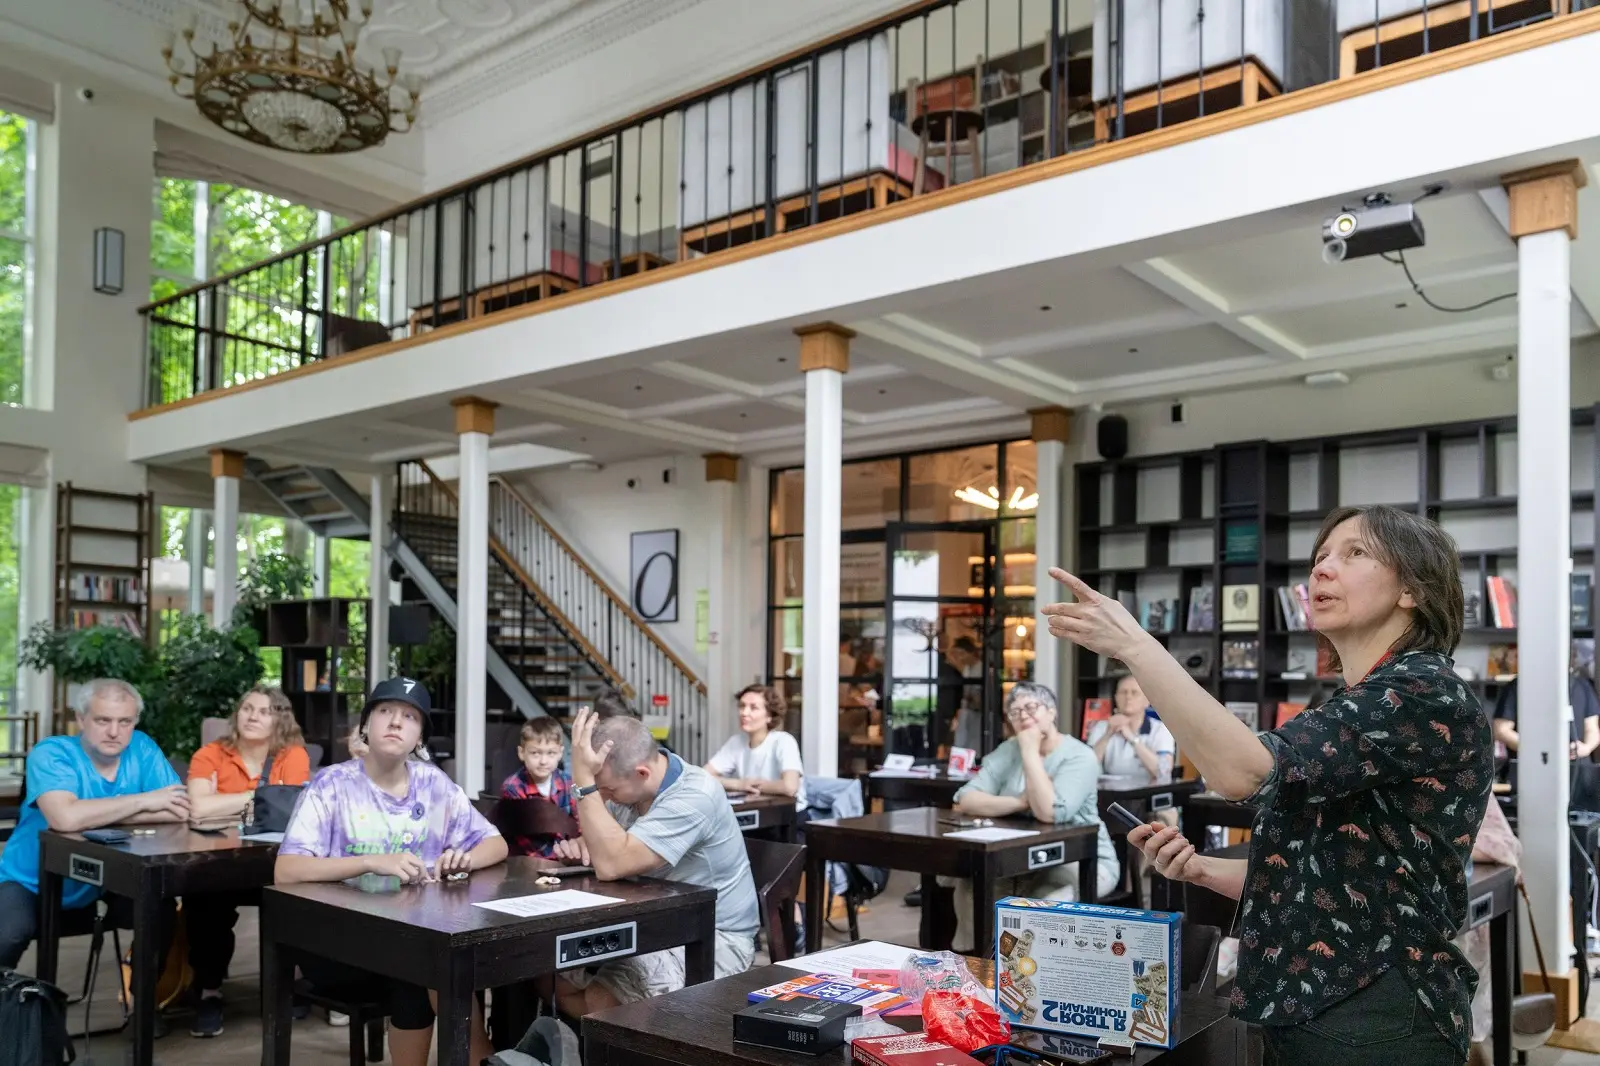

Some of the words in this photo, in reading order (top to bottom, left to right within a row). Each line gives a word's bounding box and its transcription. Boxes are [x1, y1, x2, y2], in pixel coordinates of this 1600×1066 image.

[1042, 1000, 1059, 1023] 2
[1060, 1002, 1127, 1019] ПОНИМАЙ!
[1060, 1011, 1110, 1030] ТВОЯ
[1113, 1018, 1126, 1032] Я
